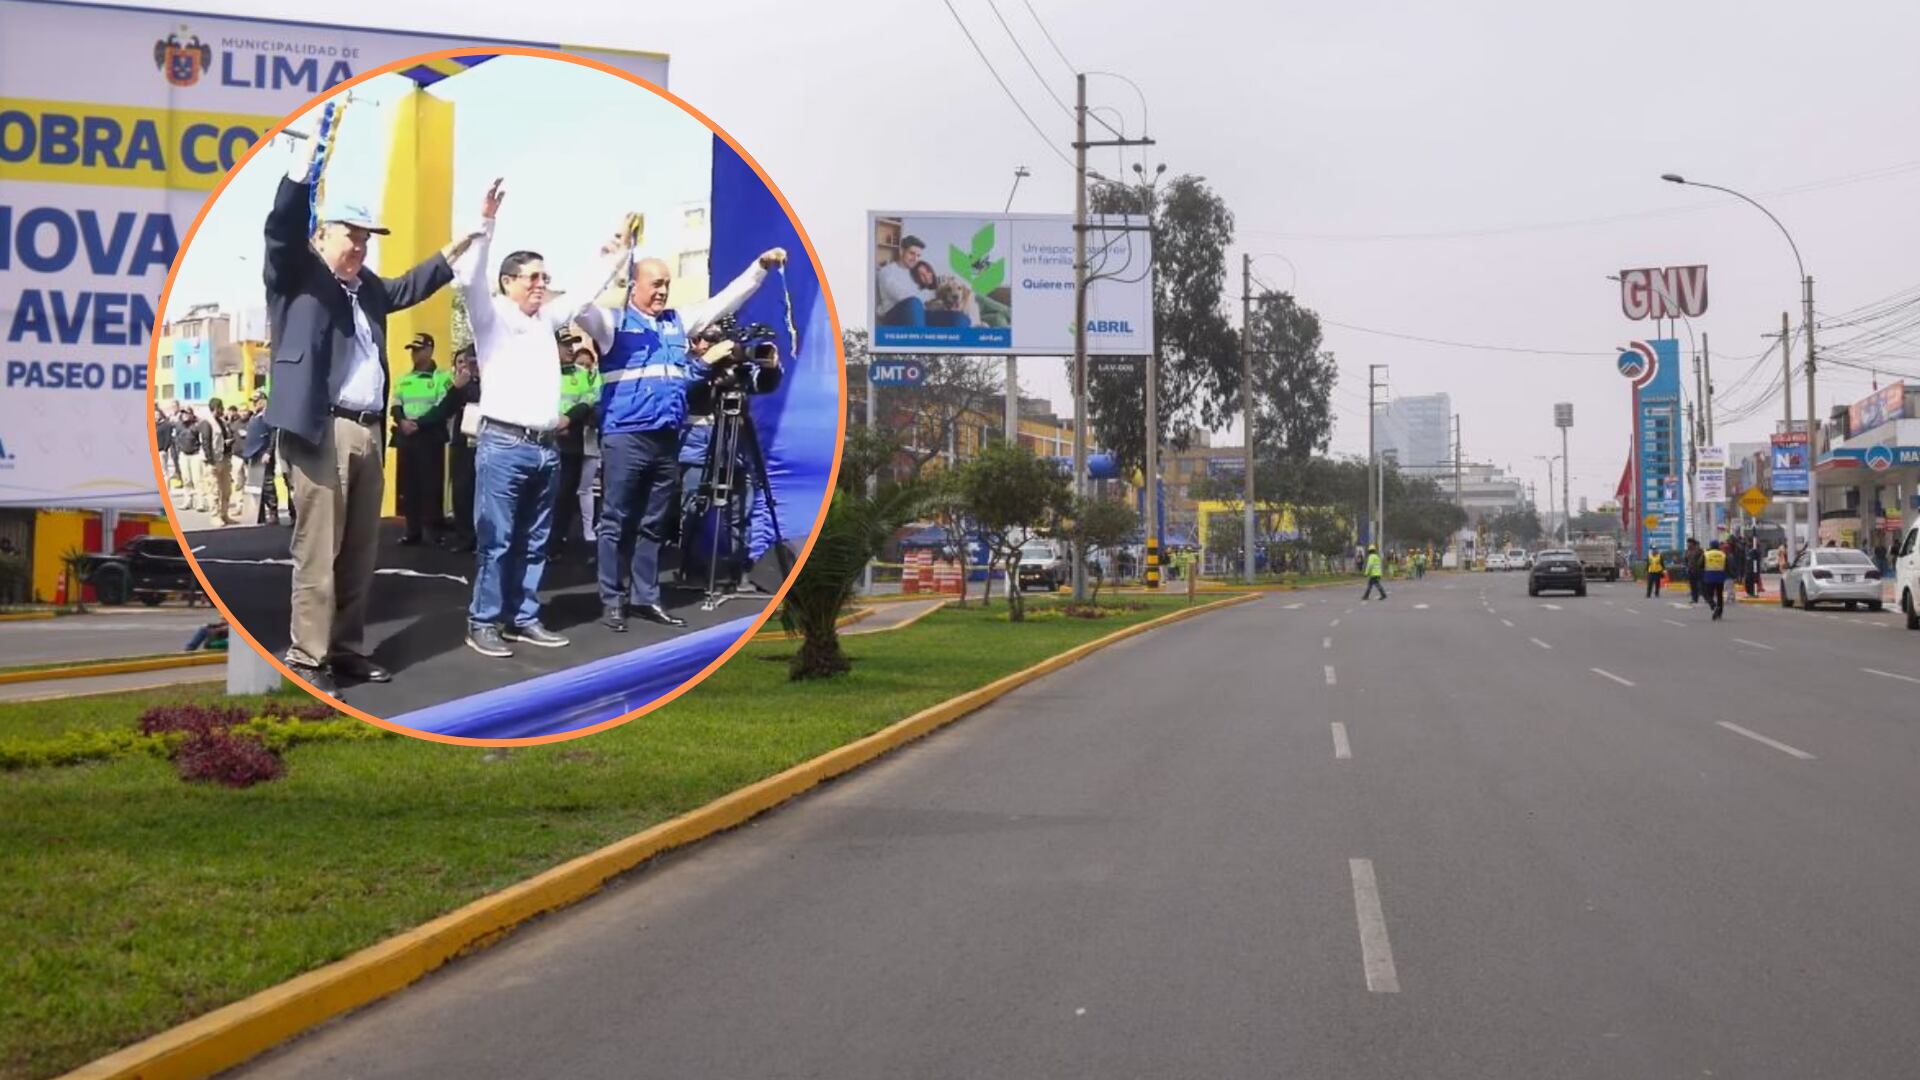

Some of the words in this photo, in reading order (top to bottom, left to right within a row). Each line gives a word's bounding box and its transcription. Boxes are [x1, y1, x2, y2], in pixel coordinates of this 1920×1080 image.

[221, 37, 337, 57] MUNICIPALIDAD
[341, 48, 360, 59] DE
[221, 51, 354, 93] LIMA
[0, 110, 166, 171] OBRA
[180, 123, 271, 174] CO
[1022, 278, 1062, 290] Quiere
[1620, 265, 1708, 320] GNV
[1086, 320, 1133, 333] ABRIL
[7, 361, 105, 389] PASEO
